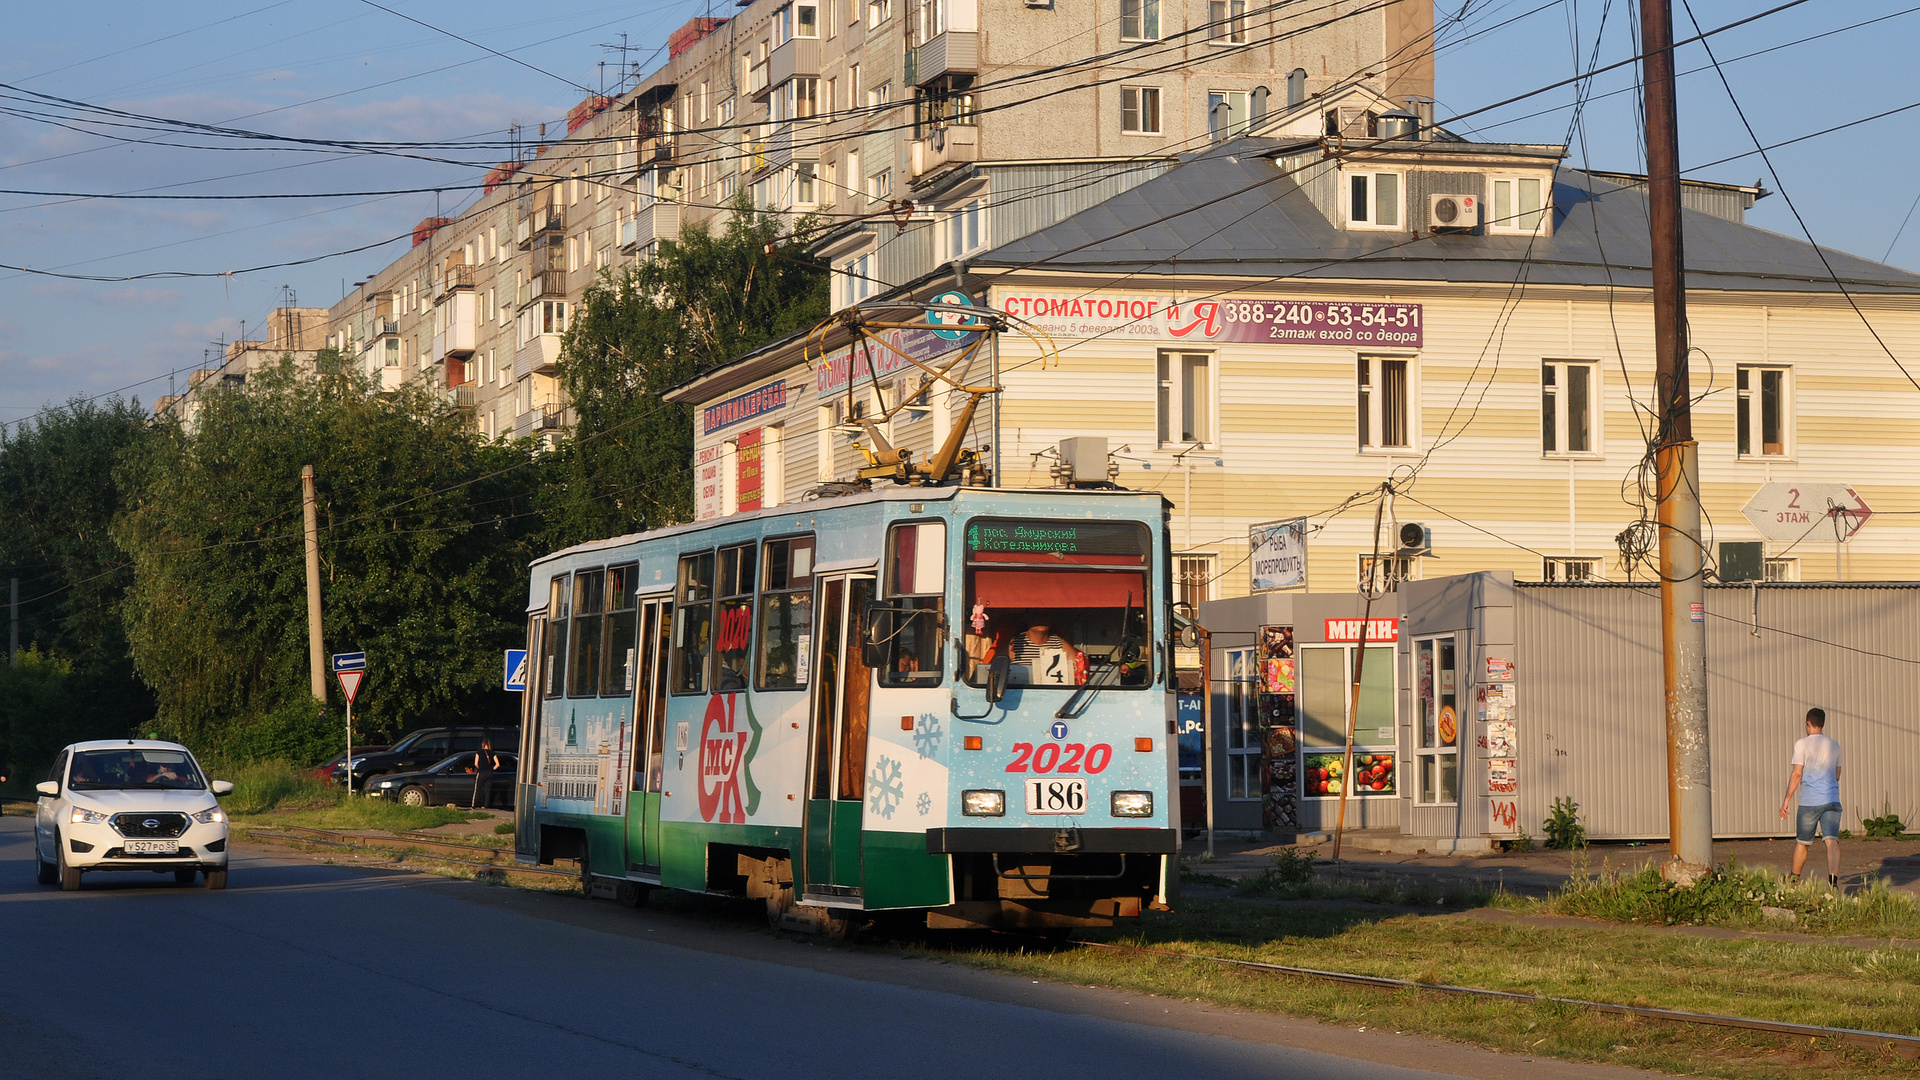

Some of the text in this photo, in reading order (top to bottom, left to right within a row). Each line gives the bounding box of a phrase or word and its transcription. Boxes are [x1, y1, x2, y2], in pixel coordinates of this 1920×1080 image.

[1004, 297, 1158, 319] СТОМАТОЛОГ
[1168, 302, 1220, 337] Я
[1069, 322, 1077, 333] 5
[1225, 303, 1419, 328] 388-240 53-54-51
[1319, 327, 1352, 341] вход
[1356, 332, 1373, 342] со
[1376, 331, 1418, 345] двора
[704, 383, 786, 432] ПАРИКМАХЕРСКАЯ
[1787, 488, 1801, 509] 2
[1776, 512, 1810, 523] ЭТАЖ
[967, 525, 980, 551] 4
[983, 538, 1078, 551] Котельникова
[1269, 535, 1288, 552] РЫБА
[1255, 555, 1304, 576] МОРЕПРОДУКТЫ
[716, 604, 751, 651] 2020
[1045, 653, 1064, 683] 4
[1004, 742, 1113, 775] 2020
[1032, 781, 1084, 811] 186
